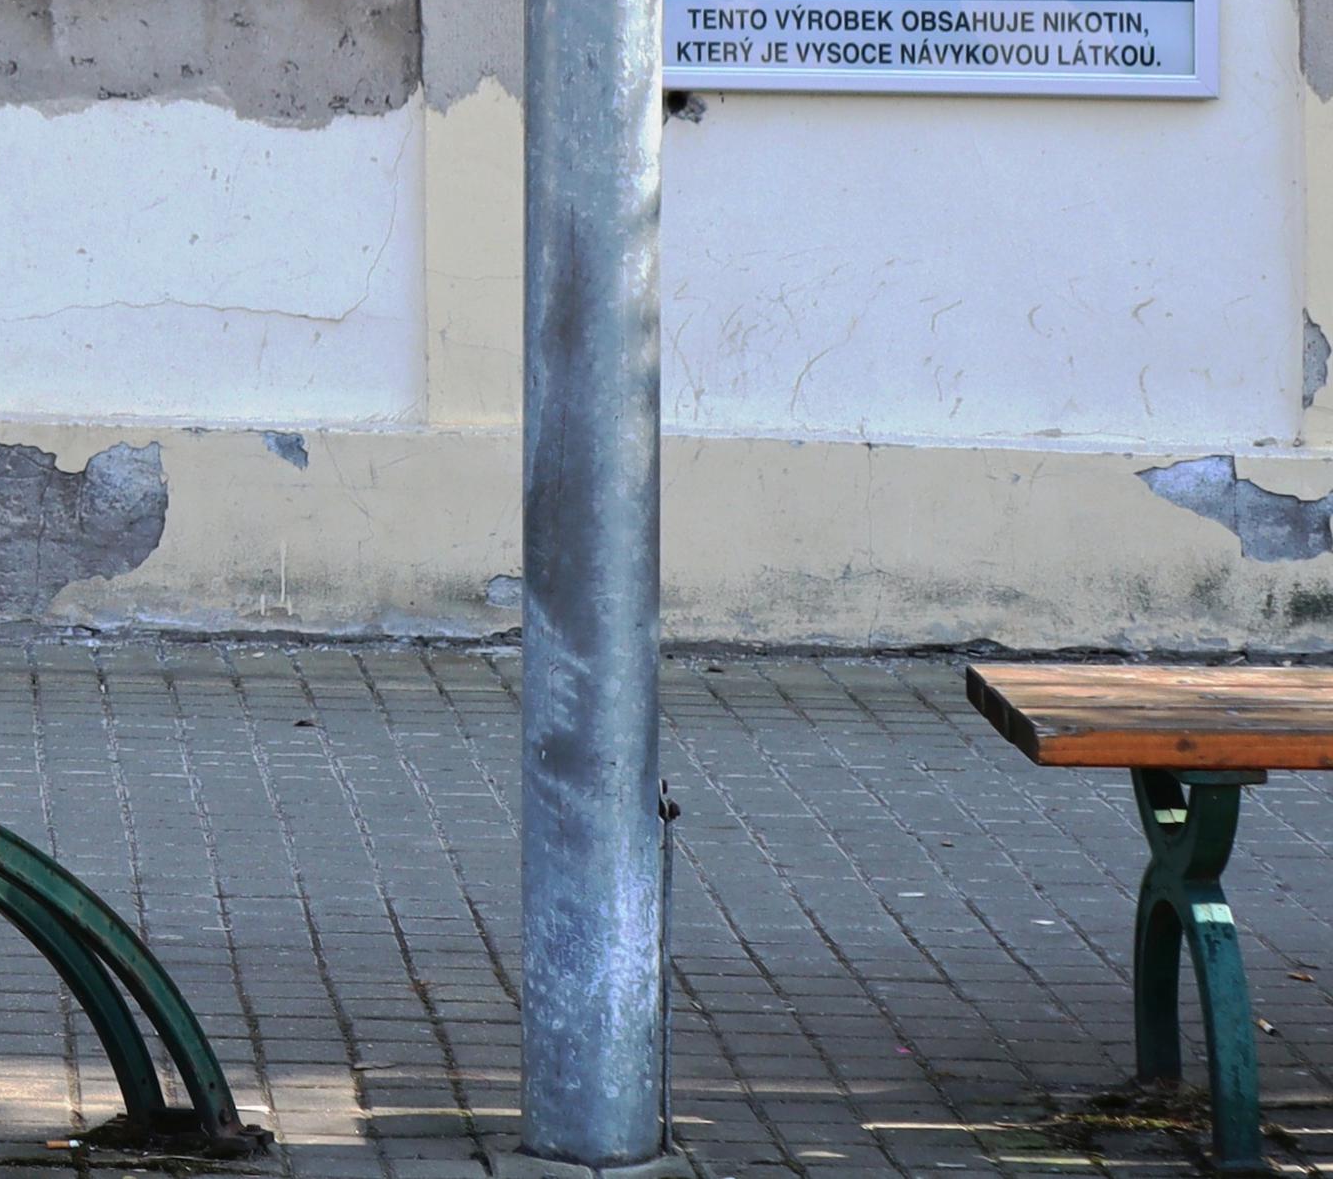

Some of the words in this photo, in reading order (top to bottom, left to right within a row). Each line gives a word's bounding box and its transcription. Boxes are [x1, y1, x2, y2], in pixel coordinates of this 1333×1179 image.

[687, 8, 768, 30] TENTO
[775, 4, 894, 31] VÝROBEK
[901, 10, 1035, 33] OBSAHUJE
[1043, 11, 1149, 37] NIKOTIN,
[677, 37, 753, 63] KTERÝ
[761, 42, 788, 63] JE
[796, 42, 892, 64] VYSOCE
[901, 38, 1049, 66] NÁVYKOVOU
[1057, 39, 1161, 67] LÁTKOU.
